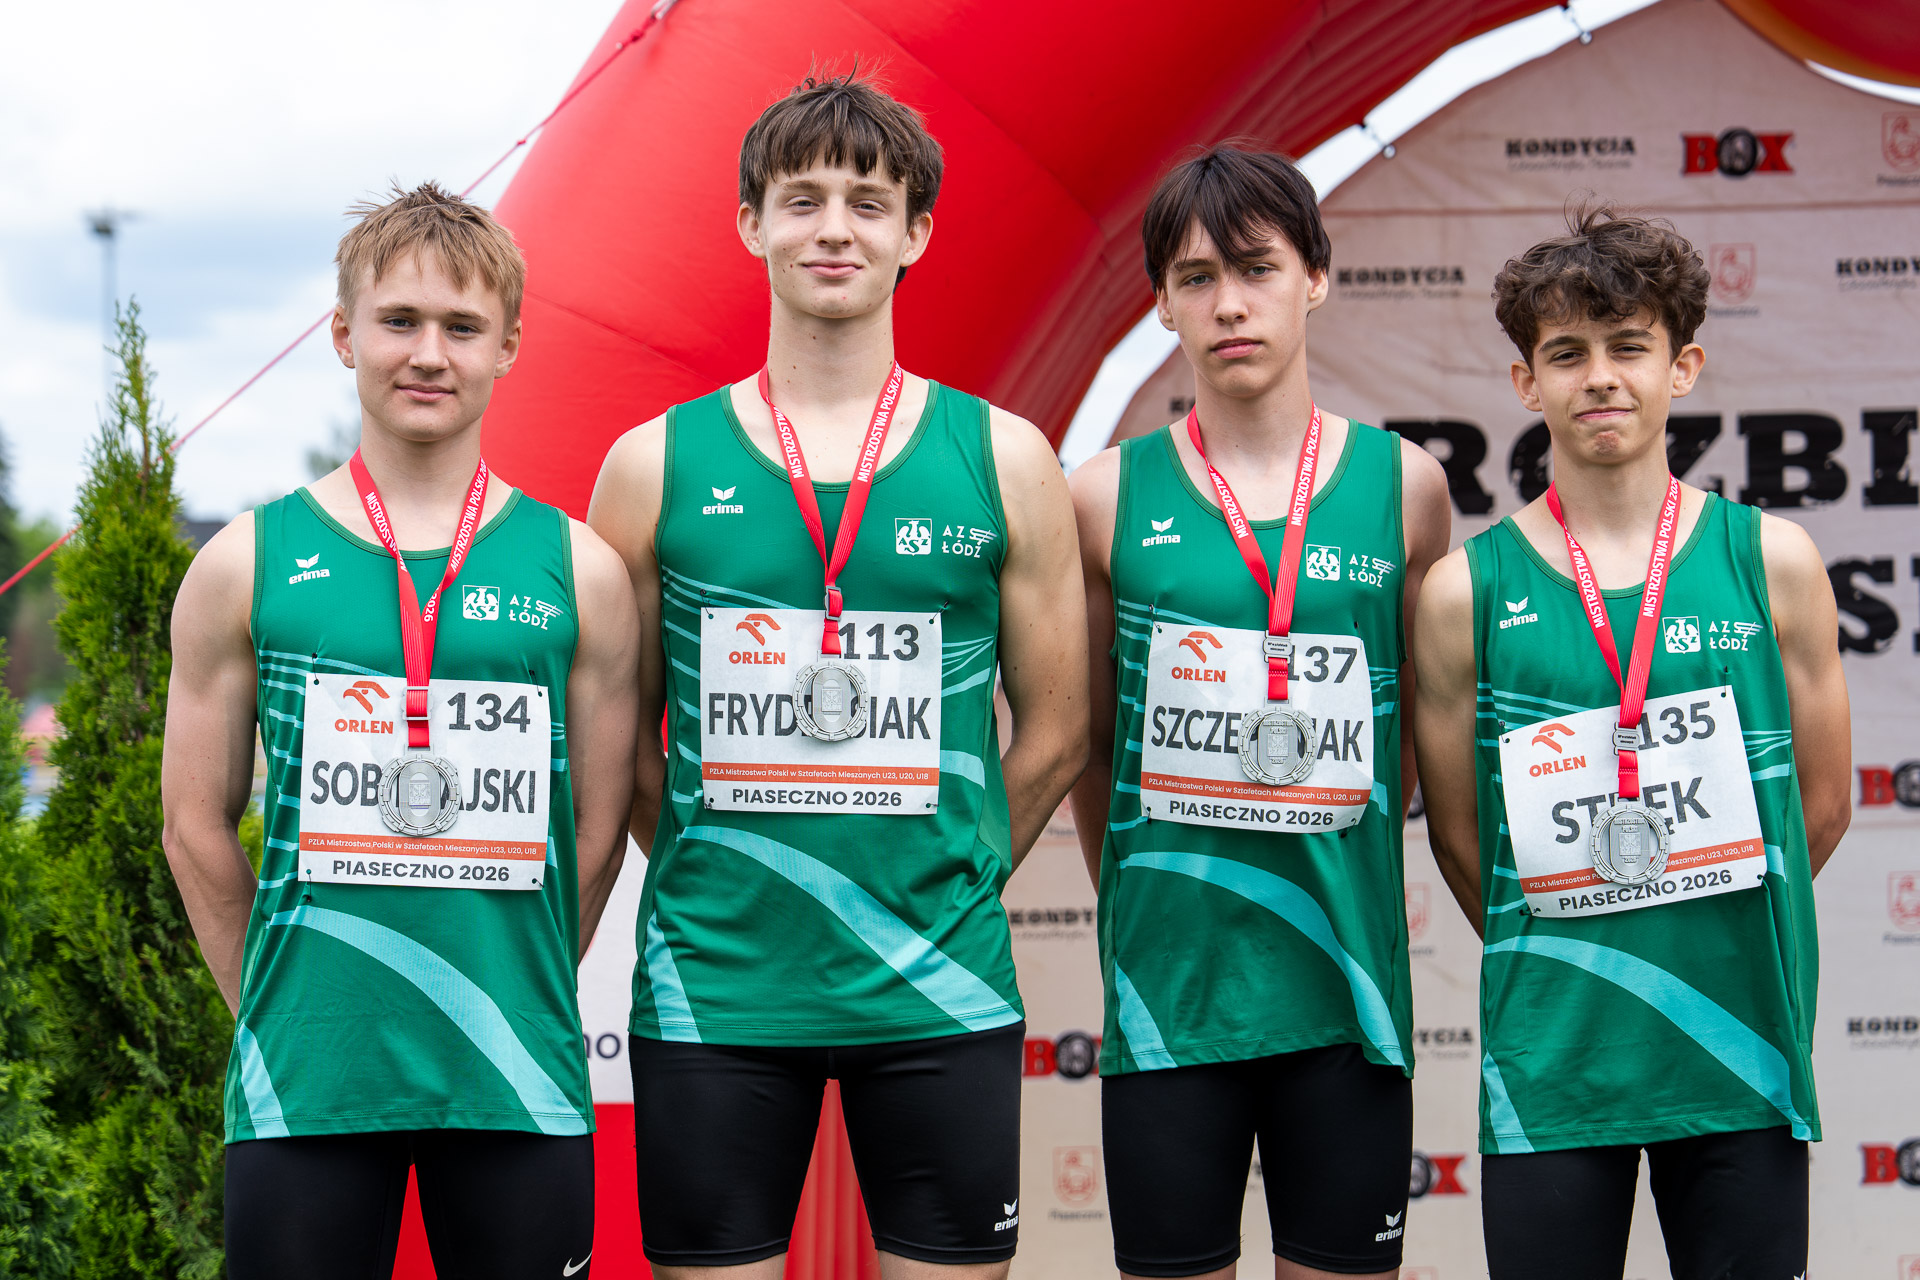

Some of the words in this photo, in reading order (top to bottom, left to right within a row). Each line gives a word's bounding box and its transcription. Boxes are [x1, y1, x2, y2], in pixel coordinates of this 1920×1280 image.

[1682, 128, 1795, 176] BOX
[857, 408, 890, 483] MISTRZOSTWA
[880, 379, 901, 409] POLSKI
[1291, 456, 1315, 526] MISTRZOSTWA
[1305, 421, 1320, 456] POLSKI
[703, 503, 744, 515] erima
[450, 504, 476, 573] MISTRZOSTWA
[469, 475, 487, 506] POLSKI
[1142, 534, 1181, 547] erima
[1643, 539, 1668, 618] MISTRZOSTWA
[1660, 499, 1676, 540] POLSKI
[289, 568, 331, 585] erima
[1573, 550, 1606, 629] MISTRZOSTWA
[1499, 613, 1539, 630] erima
[838, 622, 919, 661] 113
[729, 651, 786, 665] ORLEN
[1171, 666, 1226, 683] ORLEN
[447, 692, 531, 733] 134
[334, 718, 394, 735] ORLEN
[1639, 701, 1716, 751] 135
[709, 768, 725, 776] PZLA
[725, 769, 767, 777] Mistrzostwa
[768, 769, 789, 777] Polski
[798, 769, 837, 778] Sztafetach
[838, 771, 881, 780] Mieszanych
[882, 772, 898, 781] U23,
[899, 773, 914, 781] U20,
[1529, 755, 1587, 777] ORLEN
[732, 789, 848, 806] PIASECZNO
[853, 791, 902, 807] 2026
[1149, 778, 1164, 787] PZLA
[1164, 779, 1204, 791] Mistrzostwa
[1204, 784, 1225, 793] Polski
[1233, 786, 1272, 796] Sztafetach
[1272, 789, 1315, 801] Mieszanych
[1316, 792, 1332, 801] U23,
[1333, 793, 1348, 802] U20,
[1169, 801, 1281, 823] PIASECZNO
[1286, 810, 1334, 826] 2026
[308, 838, 325, 847] PZLA
[326, 839, 372, 849] Mistrzostwa
[372, 840, 394, 850] Polski
[403, 841, 444, 852] Sztafetach
[445, 844, 489, 854] Mieszanych
[490, 846, 506, 855] U23,
[507, 847, 523, 856] U20,
[524, 847, 537, 855] U18
[1707, 850, 1723, 860] U23,
[1724, 847, 1740, 857] U20,
[1741, 845, 1754, 854] U18
[333, 860, 454, 881] PIASECZNO
[459, 864, 510, 882] 2026
[1529, 880, 1547, 889] PZLA
[1547, 874, 1591, 887] Mistrzostwa
[1559, 880, 1677, 911] PIASECZNO
[1682, 870, 1733, 893] 2026
[1375, 1226, 1403, 1242] erima
